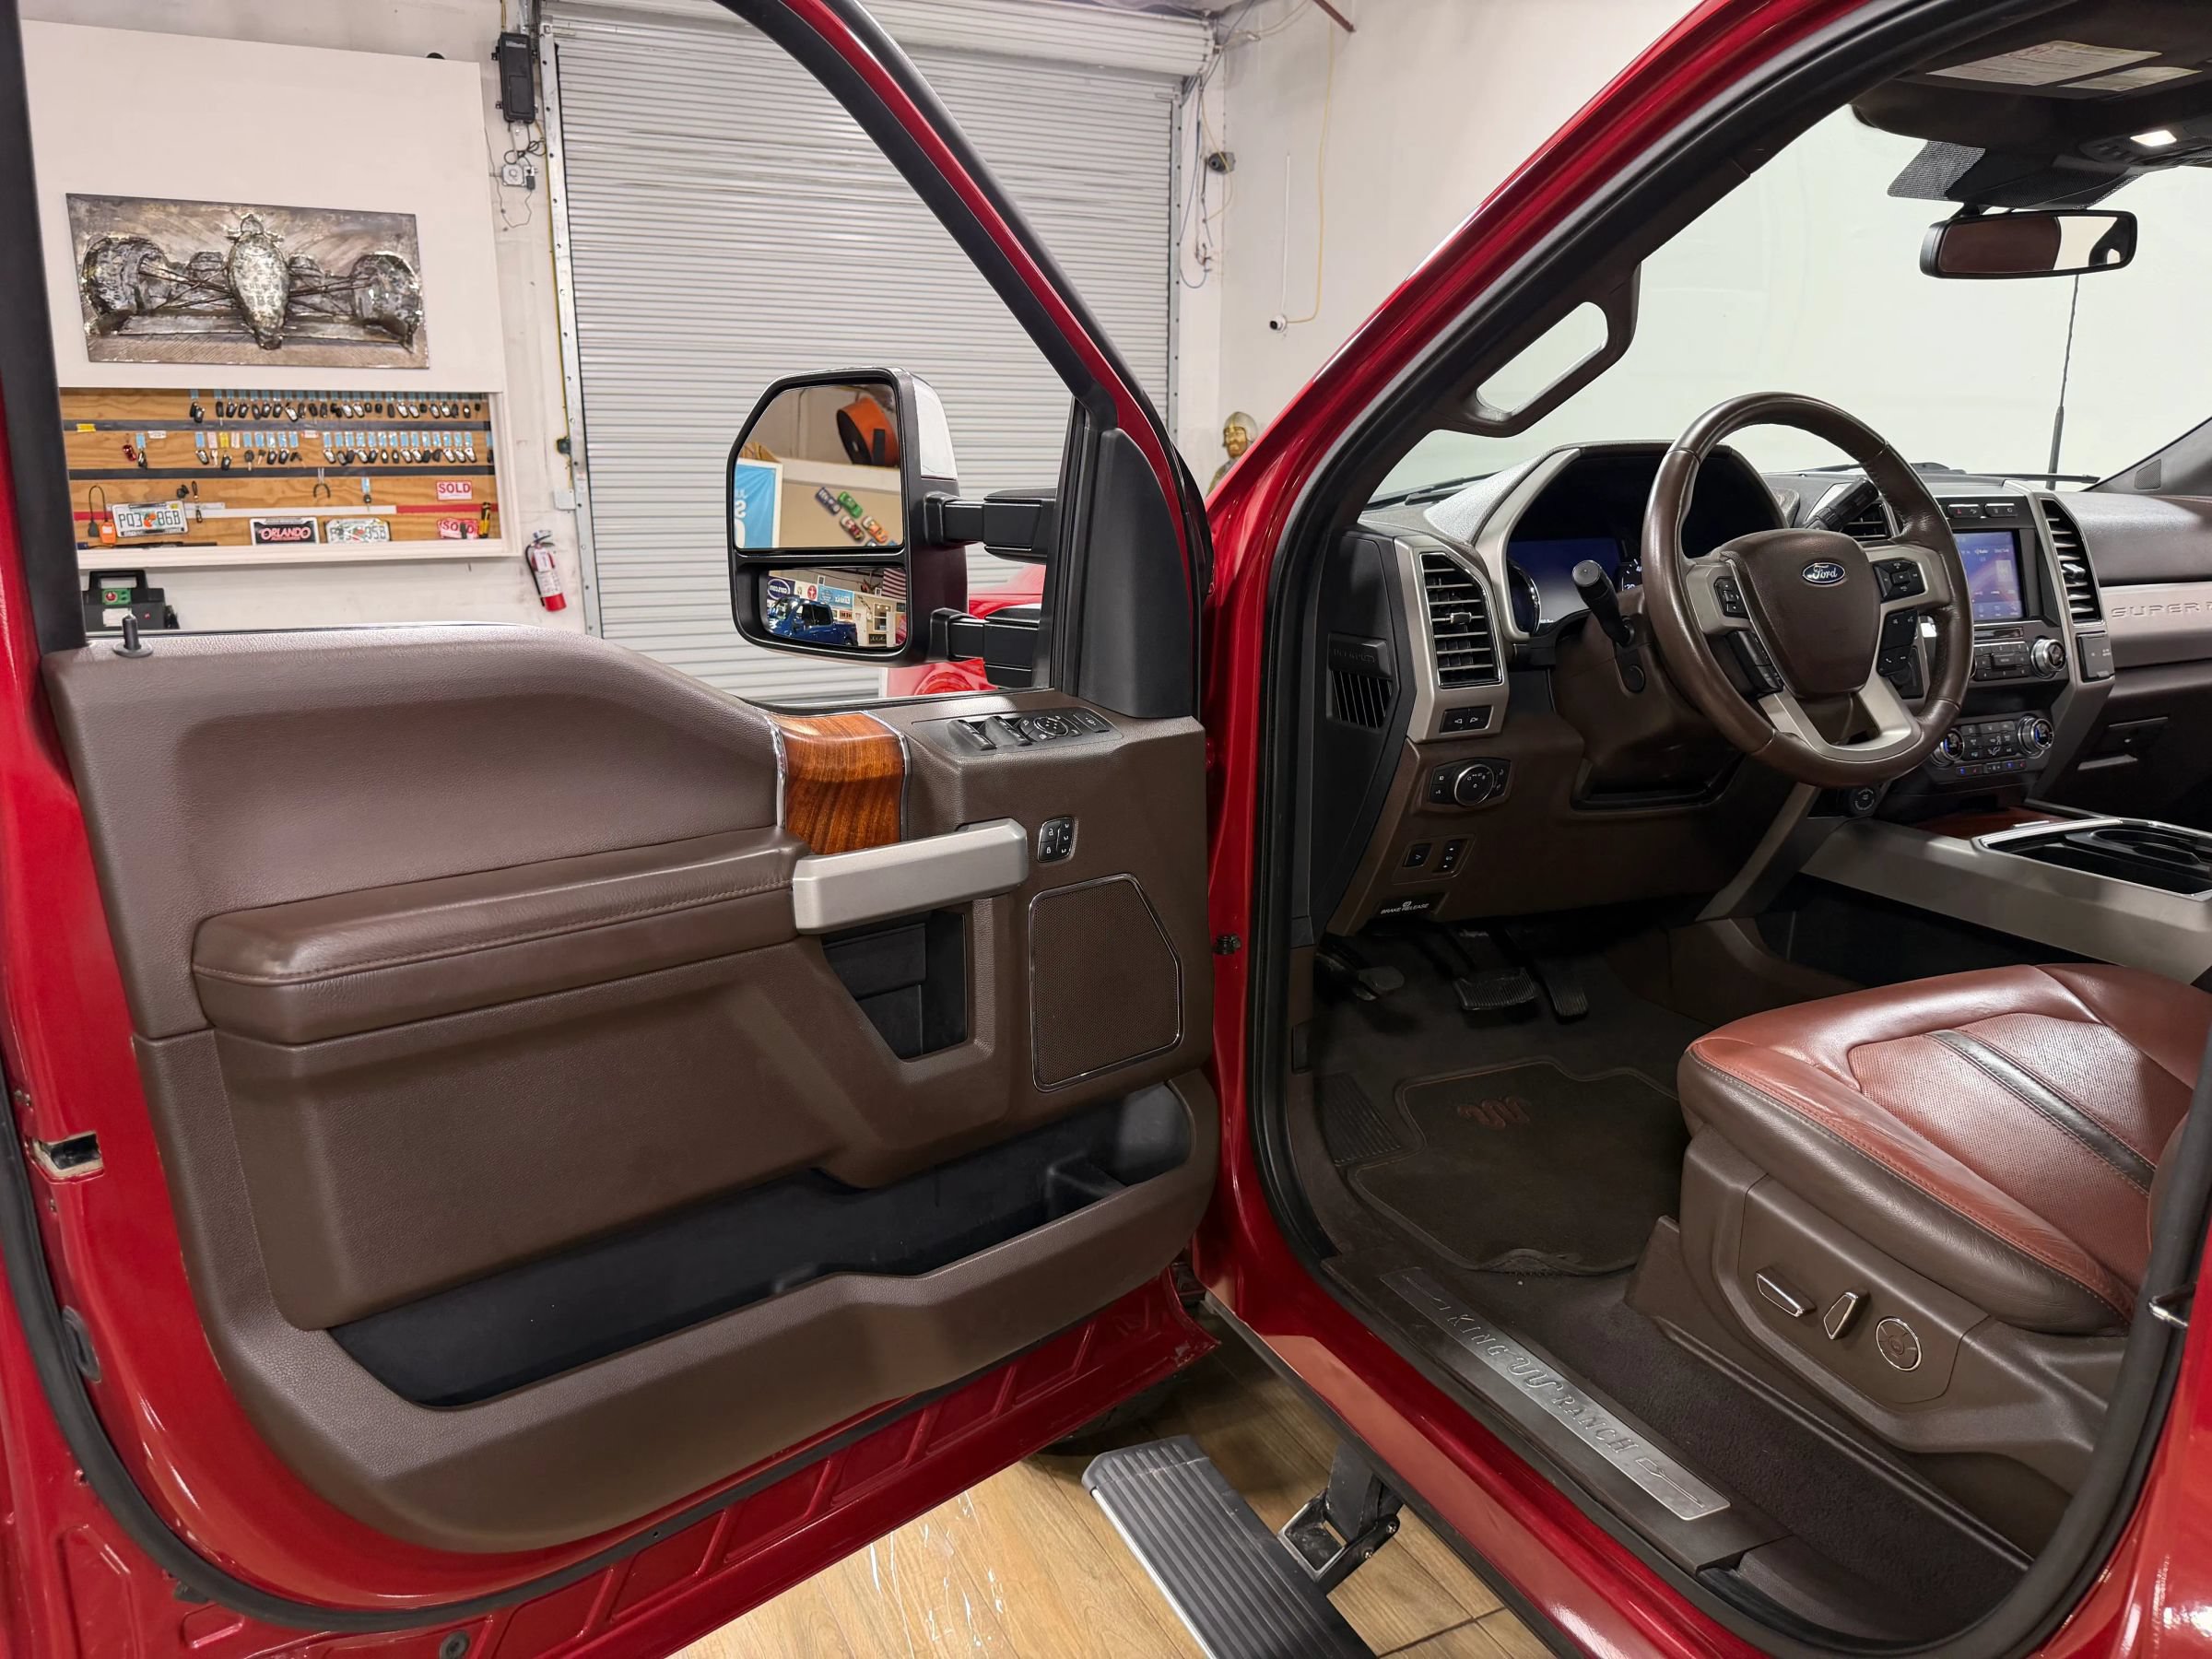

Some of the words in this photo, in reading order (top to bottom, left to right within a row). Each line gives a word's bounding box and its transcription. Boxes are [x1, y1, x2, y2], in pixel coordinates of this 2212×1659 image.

[438, 483, 472, 494] SOLD
[260, 526, 312, 540] ORLANDO
[441, 520, 475, 534] SOD
[1813, 564, 1838, 580] Ford
[2111, 602, 2200, 618] SUPER
[1401, 903, 1430, 912] RELEASE
[1446, 1313, 1510, 1357] KING
[1551, 1394, 1640, 1453] RANCH
